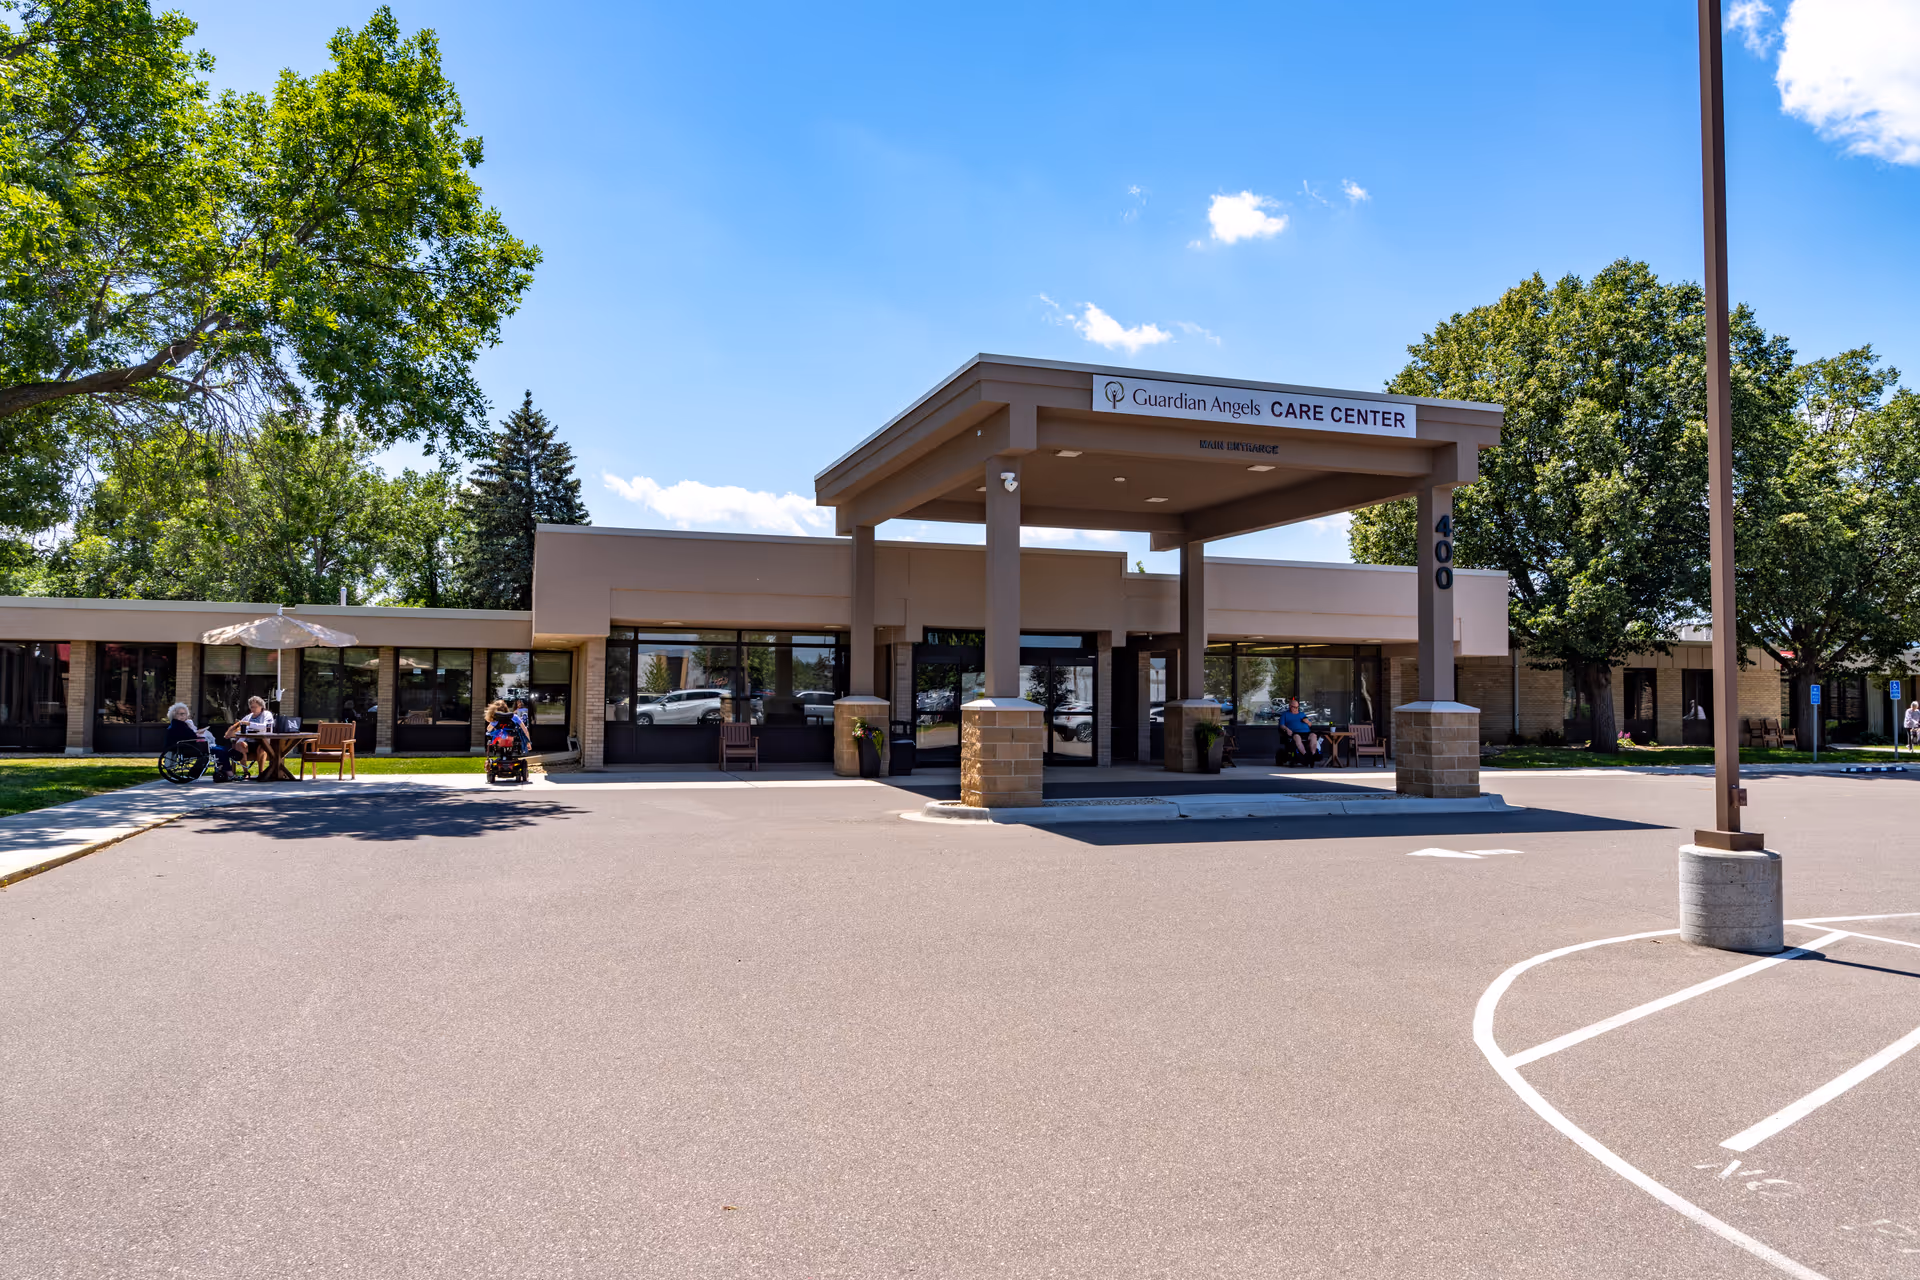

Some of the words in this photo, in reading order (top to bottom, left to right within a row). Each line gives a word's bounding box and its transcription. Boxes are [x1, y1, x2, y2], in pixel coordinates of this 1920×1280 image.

[1132, 388, 1206, 411] Guardian
[1210, 396, 1261, 419] Angels
[1271, 401, 1324, 421] CARE
[1331, 406, 1406, 428] CENTER
[1435, 515, 1453, 590] 400
